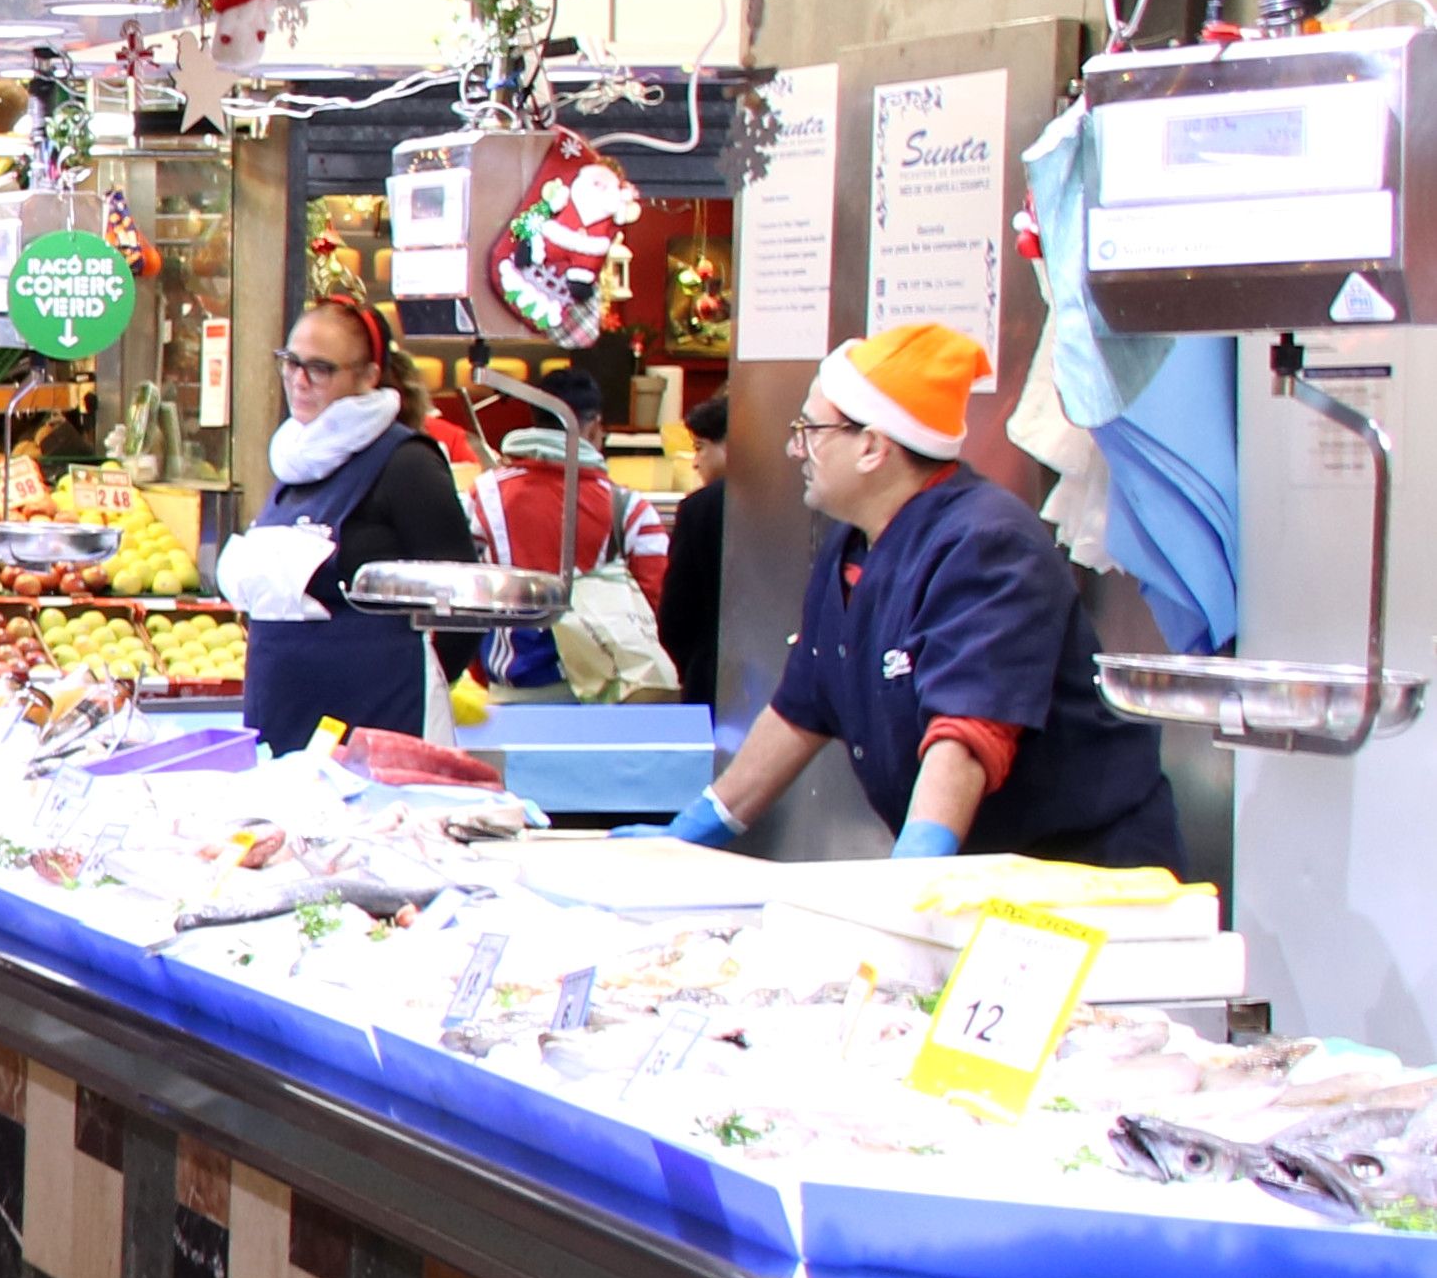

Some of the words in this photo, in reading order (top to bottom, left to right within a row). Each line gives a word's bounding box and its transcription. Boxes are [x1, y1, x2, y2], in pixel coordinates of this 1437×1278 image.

[901, 128, 990, 167] Sunta
[27, 254, 83, 275] RACÓ
[85, 258, 113, 275] DE
[15, 275, 124, 303] COMERÇ
[34, 297, 105, 318] VERD
[963, 1000, 1005, 1043] 12
